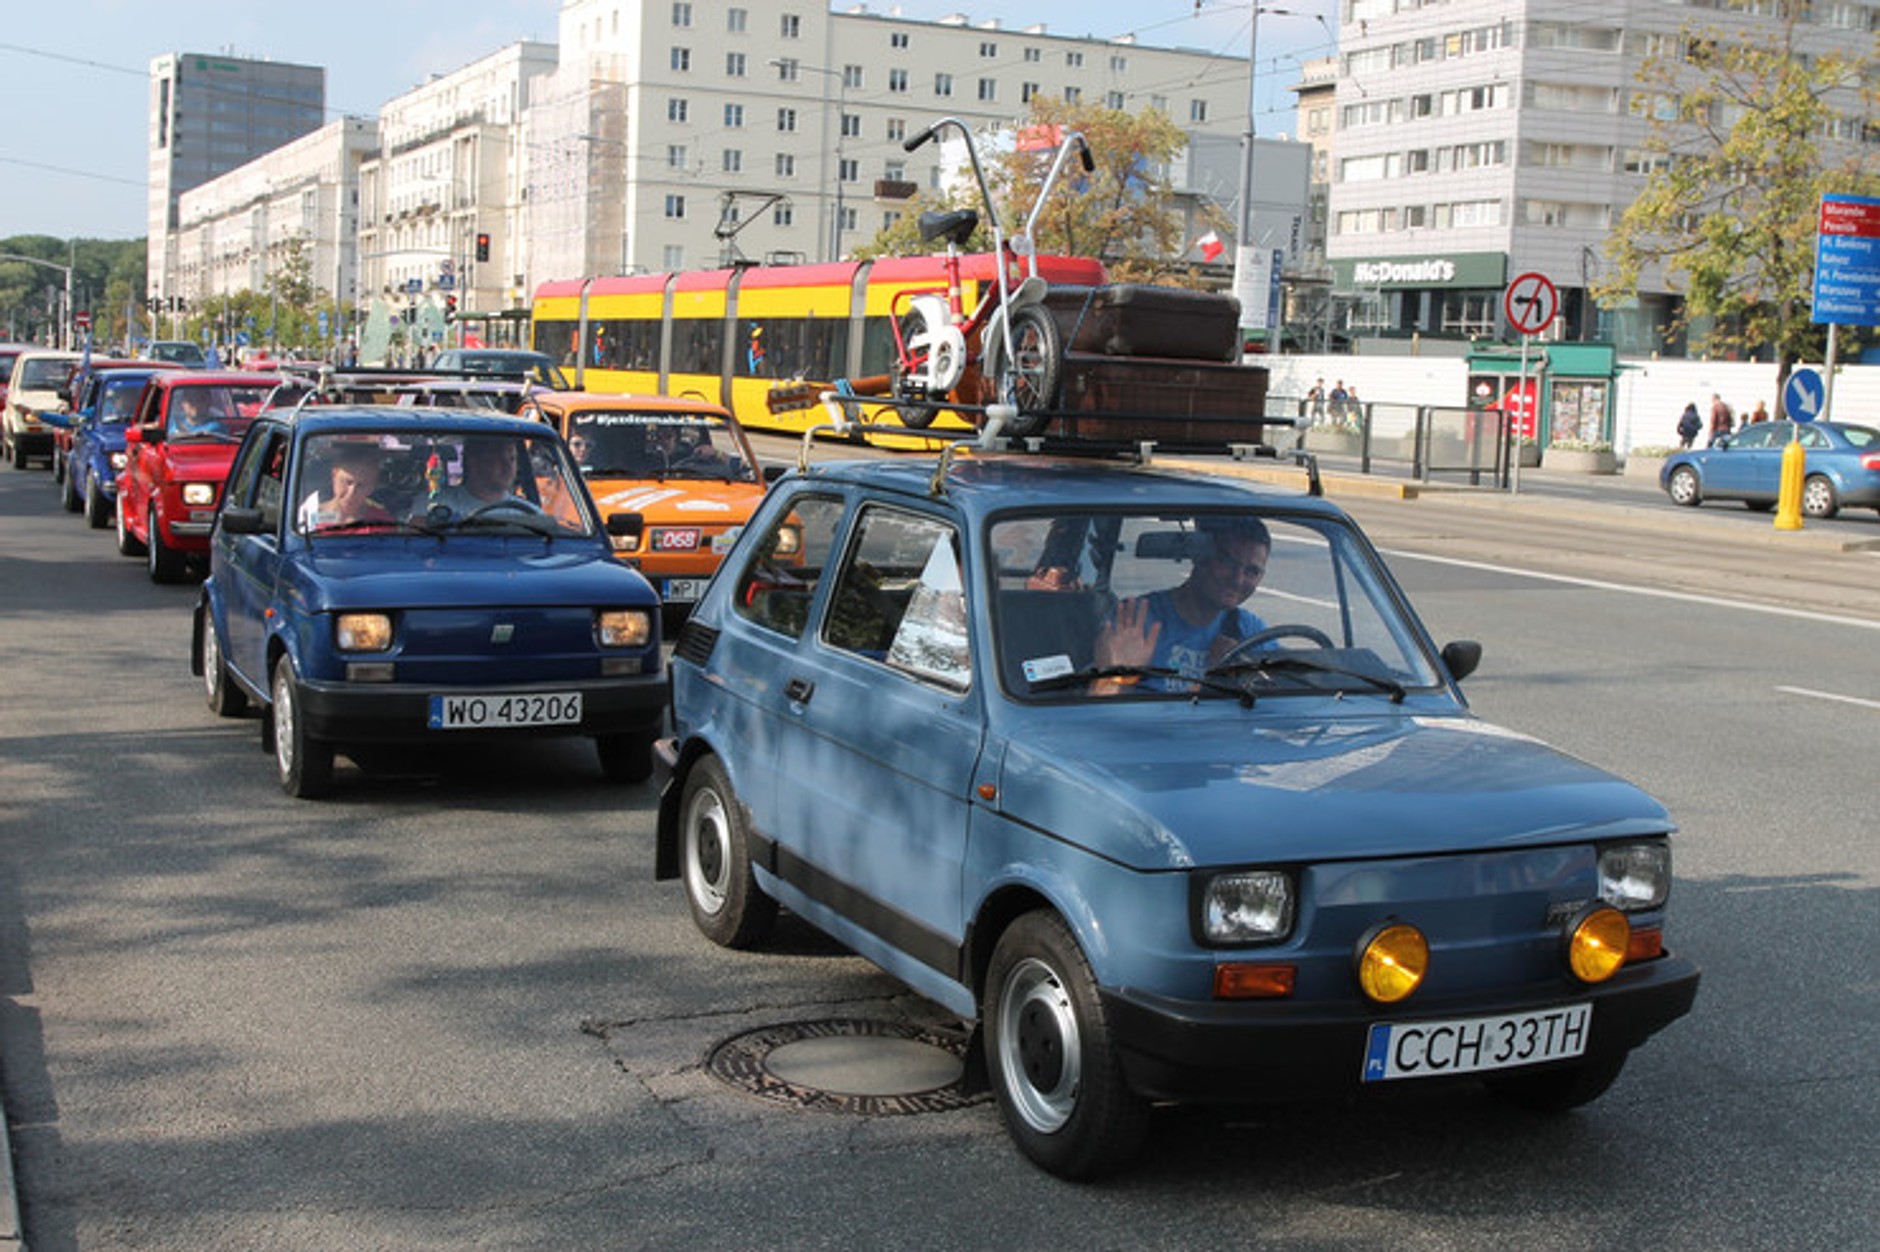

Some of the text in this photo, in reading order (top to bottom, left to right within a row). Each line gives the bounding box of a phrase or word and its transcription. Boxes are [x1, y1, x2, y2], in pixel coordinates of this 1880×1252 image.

[1353, 258, 1455, 283] McDonald's
[448, 698, 487, 725] WO
[497, 695, 578, 723] 43206
[1395, 1023, 1485, 1072] CCH
[1494, 1009, 1587, 1062] 33TH
